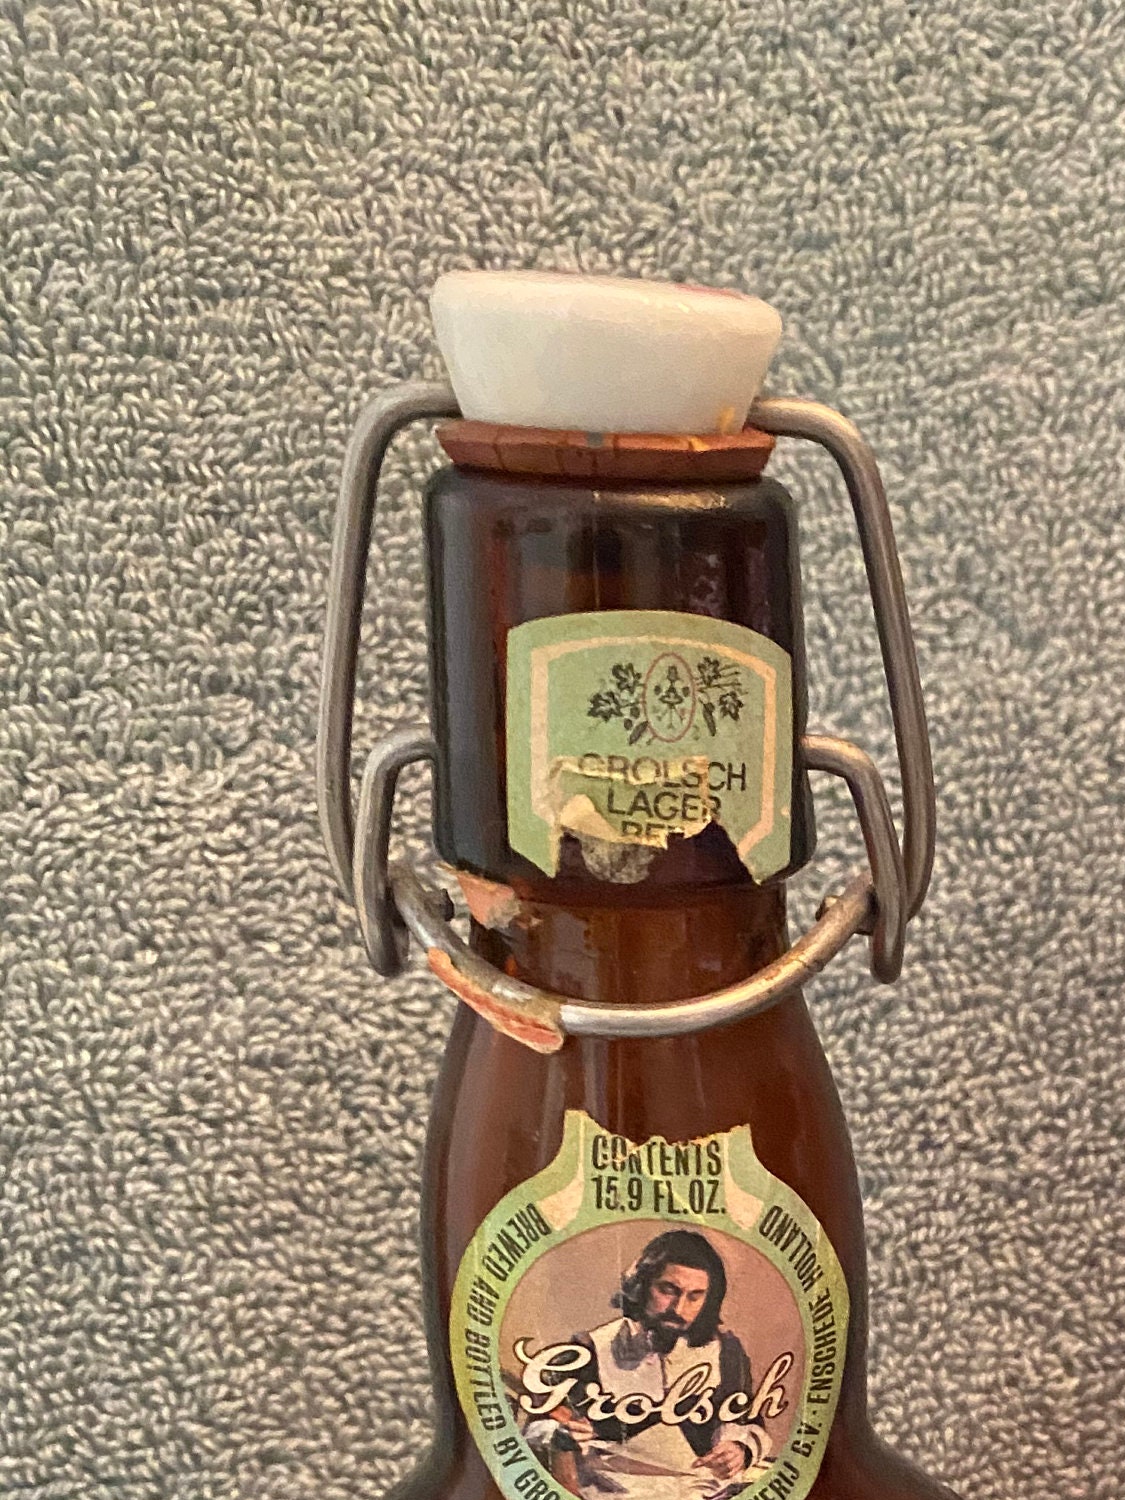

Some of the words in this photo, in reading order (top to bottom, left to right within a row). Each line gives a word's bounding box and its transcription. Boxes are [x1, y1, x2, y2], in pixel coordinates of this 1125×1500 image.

[607, 789, 722, 823] LAGER
[592, 1134, 723, 1177] CONTENTS
[590, 1175, 643, 1213] 15.9
[482, 1202, 552, 1282] BREWED
[758, 1205, 824, 1294] HOLLAND
[467, 1273, 501, 1327] AND
[464, 1327, 508, 1431] BOTTLED
[807, 1287, 838, 1404] ENSCHEDE
[512, 1337, 796, 1426] Grolsch
[493, 1436, 528, 1468] BY
